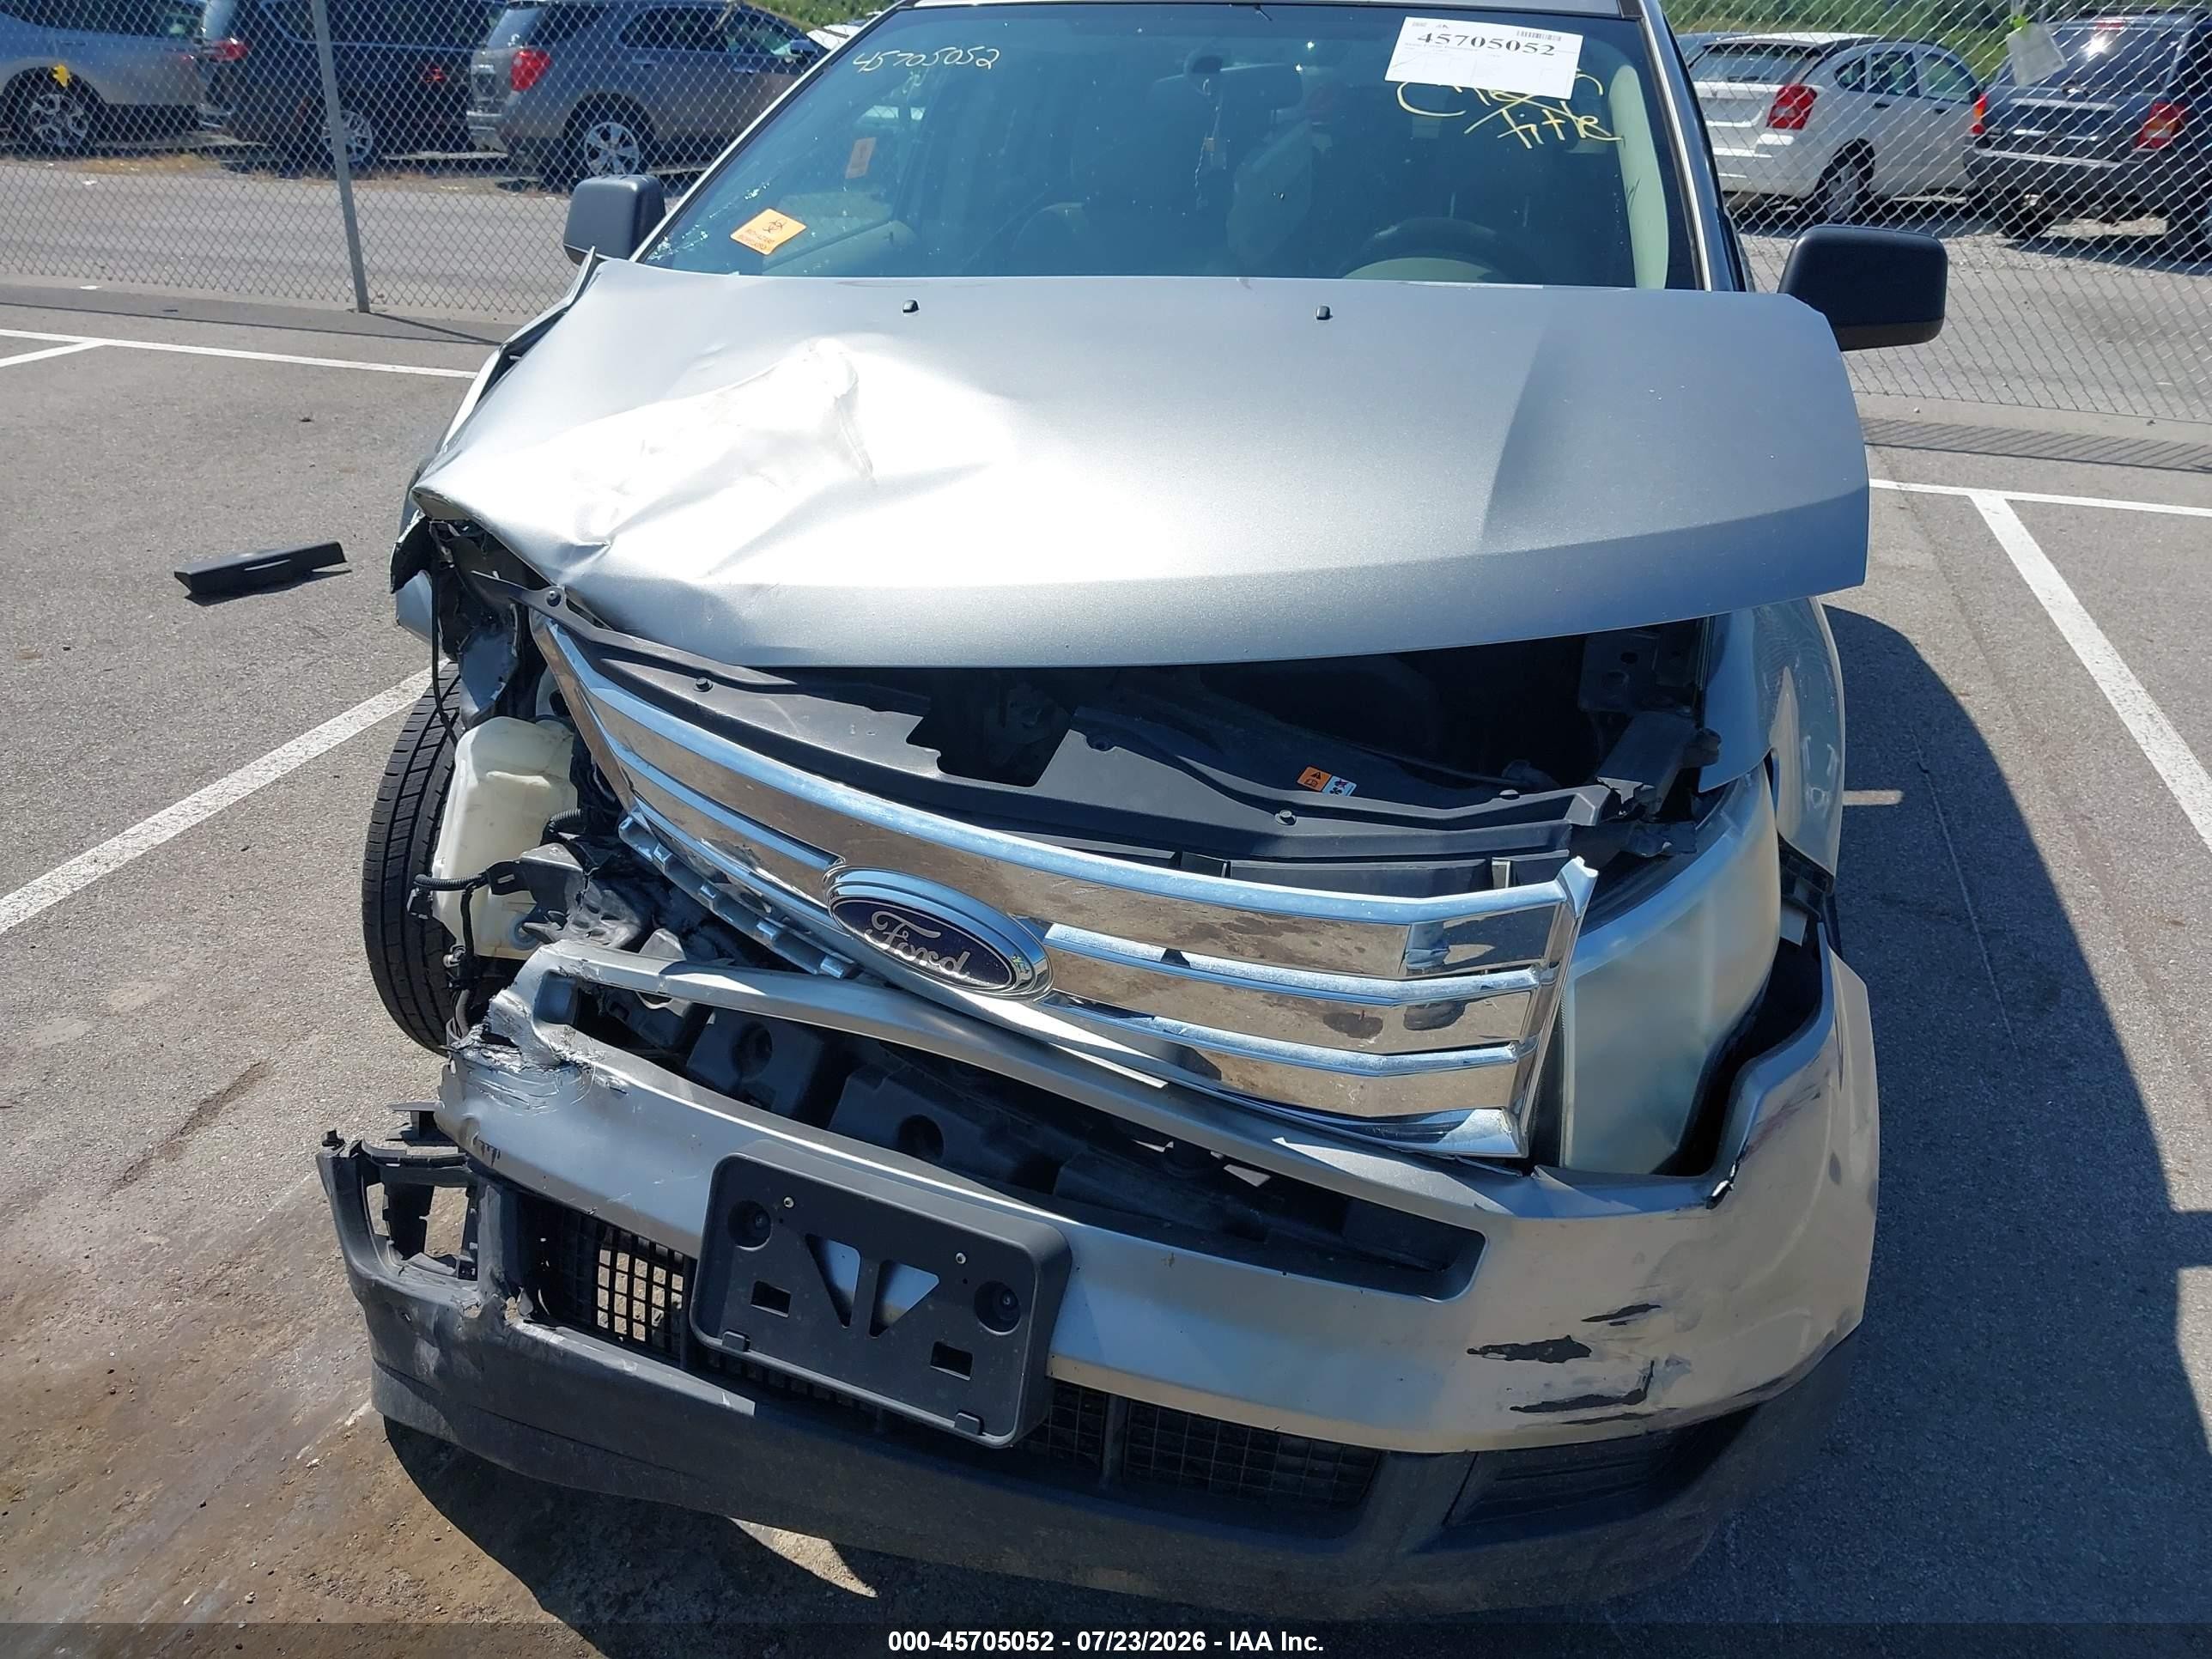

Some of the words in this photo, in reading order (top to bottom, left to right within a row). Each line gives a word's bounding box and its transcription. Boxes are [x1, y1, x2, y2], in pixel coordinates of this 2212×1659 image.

[1418, 33, 1555, 56] 45705052
[853, 46, 1000, 72] 45705052
[864, 911, 970, 979] Ford
